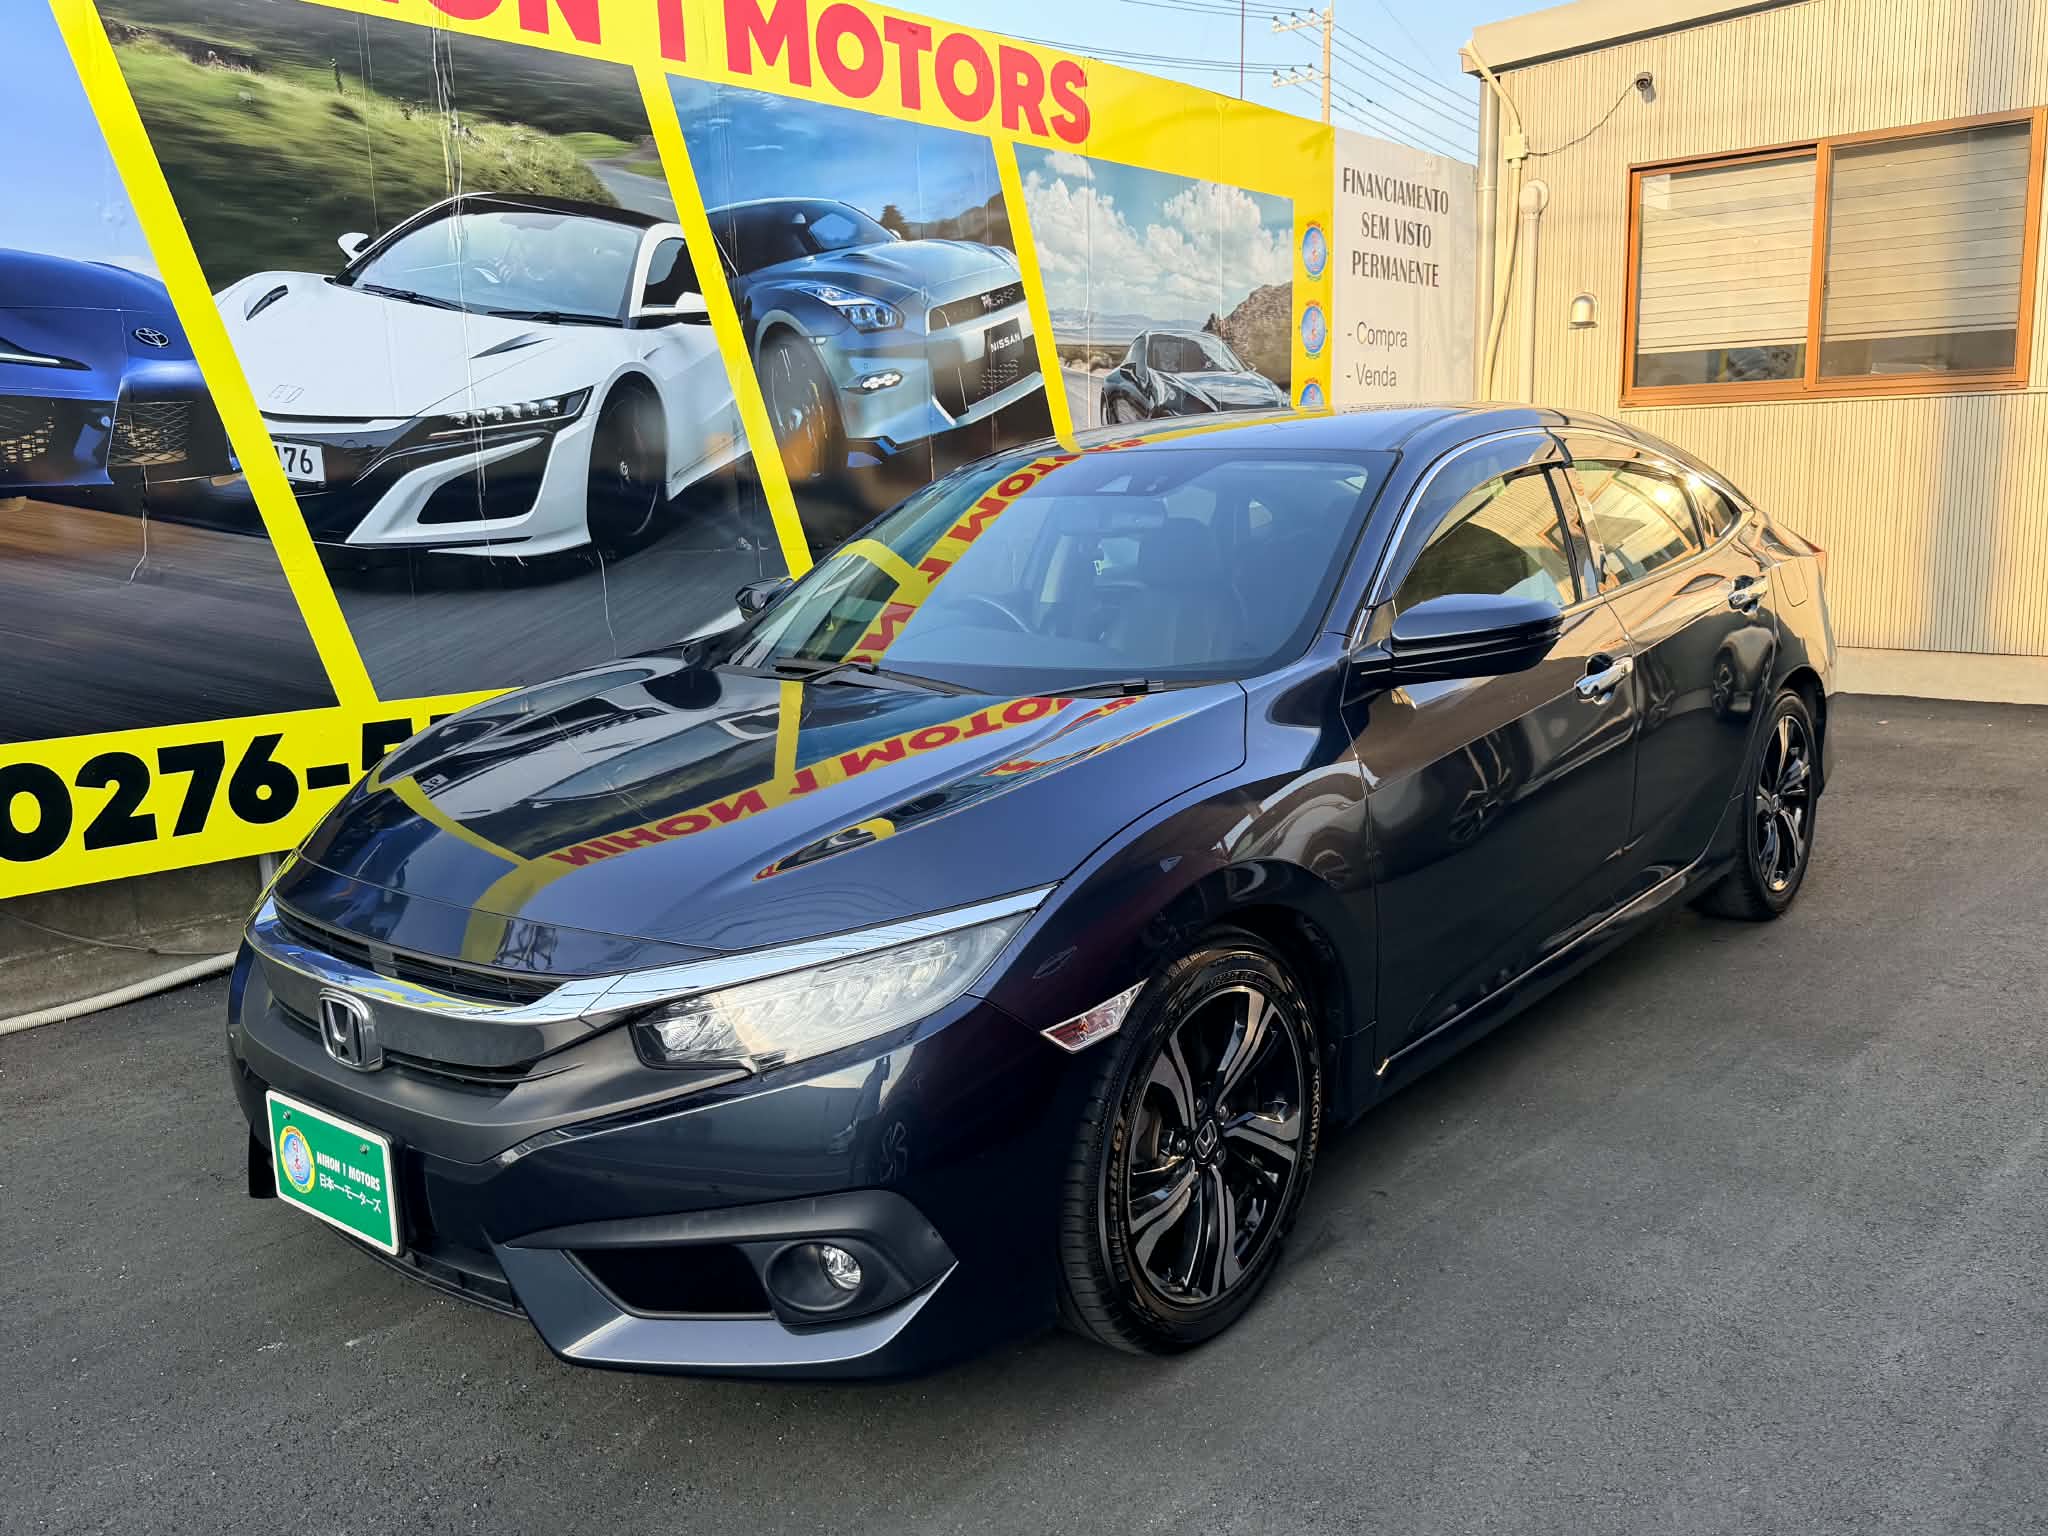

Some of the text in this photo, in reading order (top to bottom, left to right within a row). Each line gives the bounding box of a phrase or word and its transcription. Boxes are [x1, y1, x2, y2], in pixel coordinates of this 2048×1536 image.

[722, 0, 1091, 144] MOTORS
[1343, 167, 1449, 215] FINANCIAMENTO
[1361, 211, 1432, 249] SEM VISTO
[1352, 250, 1440, 288] PERMANENTE
[990, 333, 1021, 353] NISSAN
[1356, 321, 1408, 352] Compra
[1356, 363, 1397, 387] Venda
[273, 445, 314, 475] 76
[316, 1151, 341, 1173] NIHON
[348, 1165, 381, 1192] MOTORS
